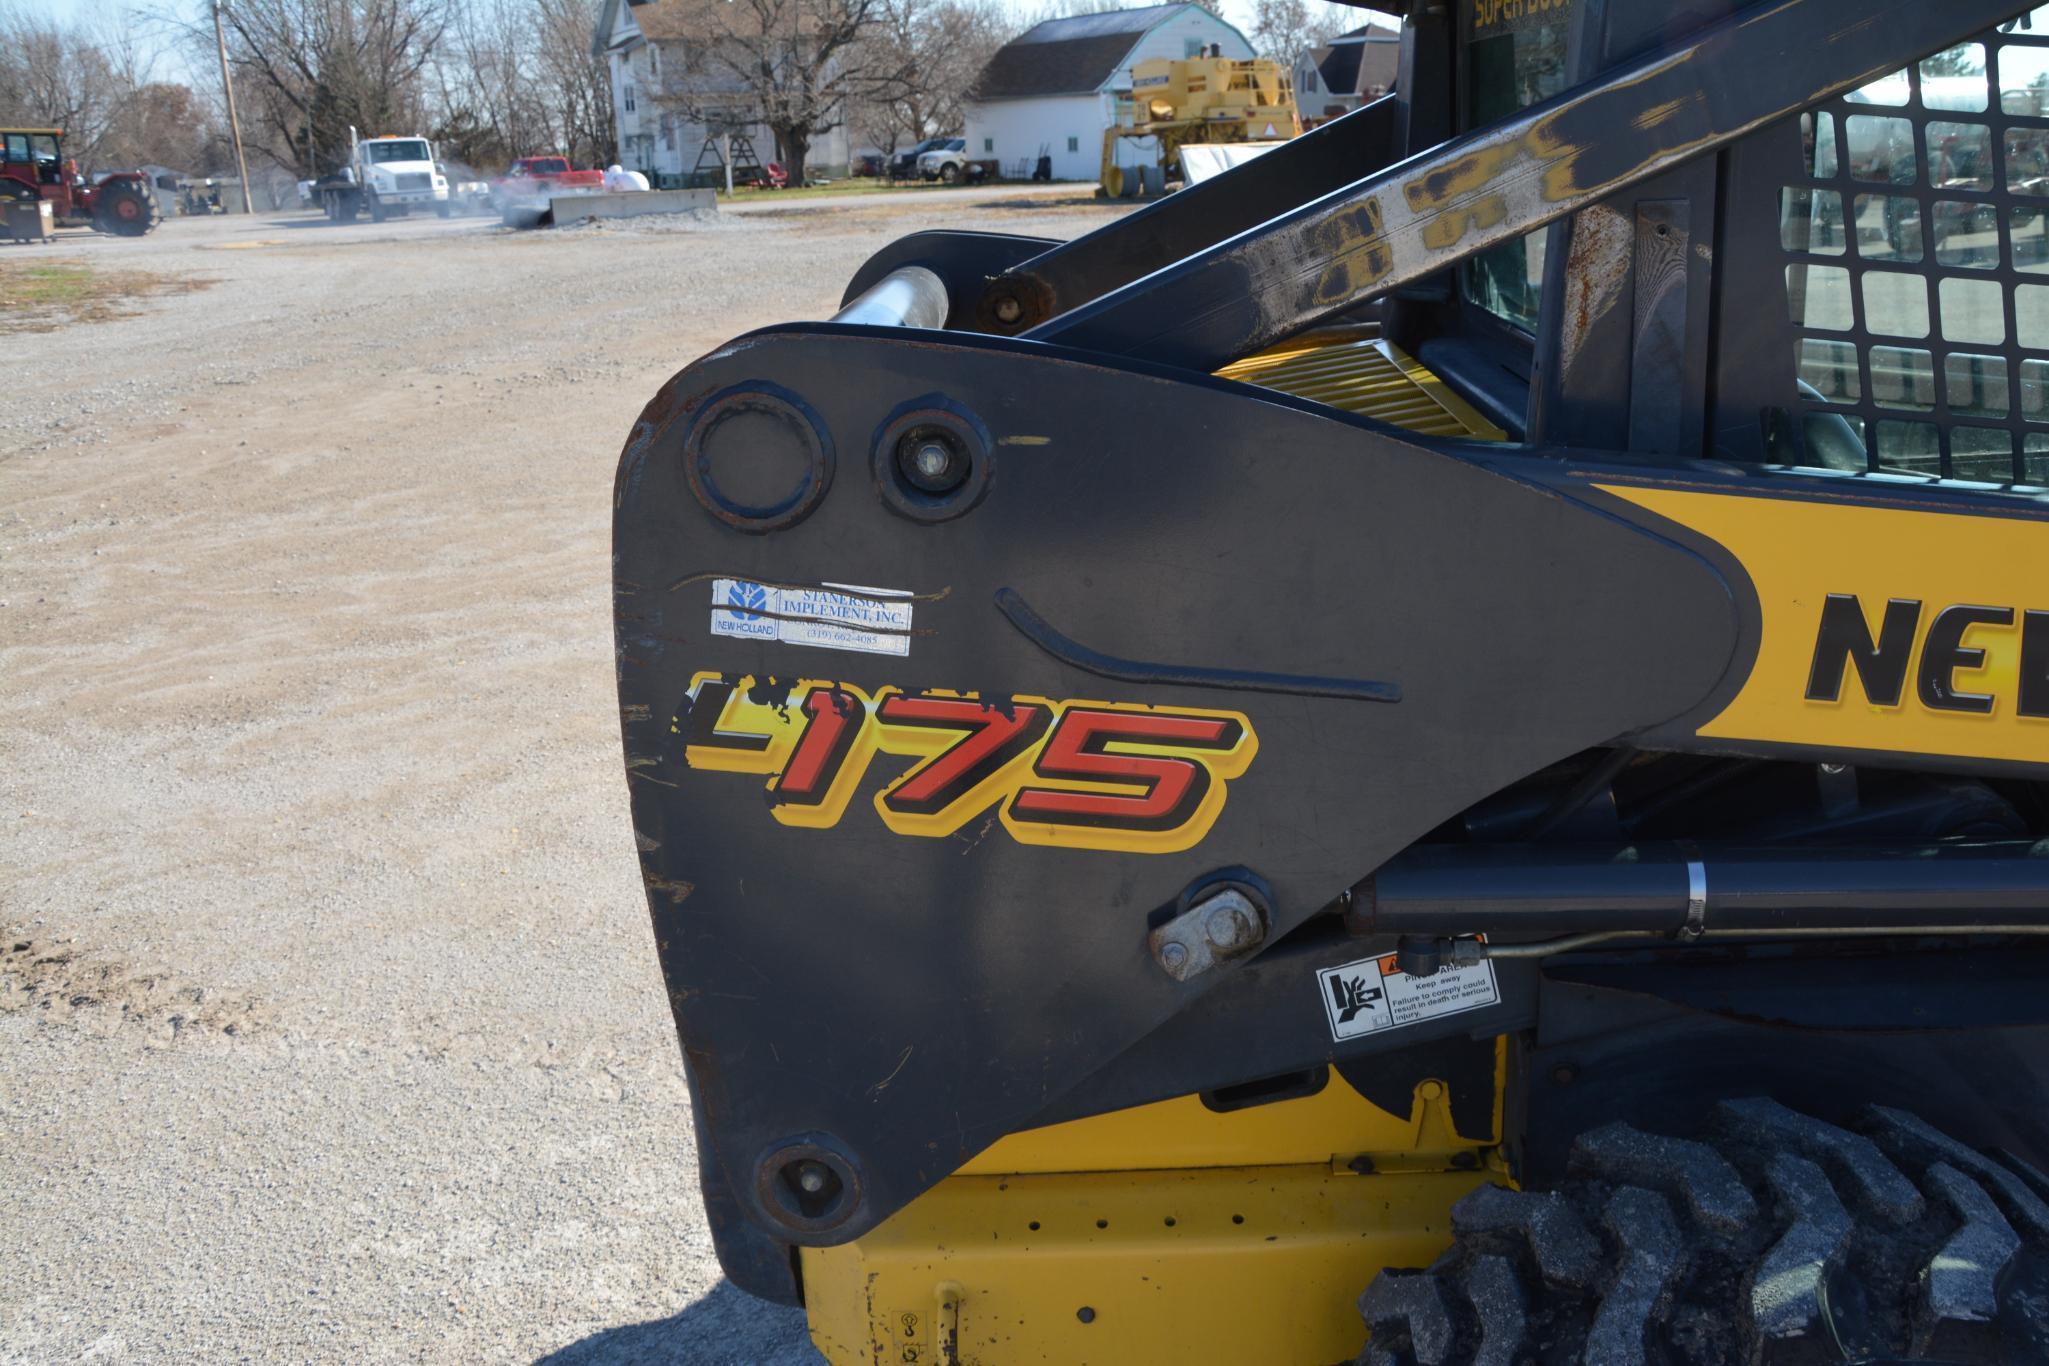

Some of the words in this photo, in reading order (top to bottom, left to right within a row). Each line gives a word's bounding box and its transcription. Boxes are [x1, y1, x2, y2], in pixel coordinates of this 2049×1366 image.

[784, 600, 871, 622] IMPLEMENT,
[875, 611, 905, 625] INC.
[717, 620, 734, 631] NEW
[736, 623, 774, 635] HOLLAND
[806, 628, 832, 640] (319)
[1804, 592, 2049, 716] NE
[1392, 995, 1420, 1007] Failure
[1422, 991, 1430, 999] to
[1432, 984, 1461, 998] comply
[1463, 978, 1486, 990] could
[1415, 980, 1437, 991] Keep
[1440, 975, 1461, 985] away
[1394, 1002, 1417, 1014] result
[1418, 1000, 1426, 1009] in
[1427, 995, 1450, 1006] death
[1451, 993, 1460, 1001] or
[1462, 986, 1491, 998] serious
[1396, 1010, 1421, 1022] injury.
